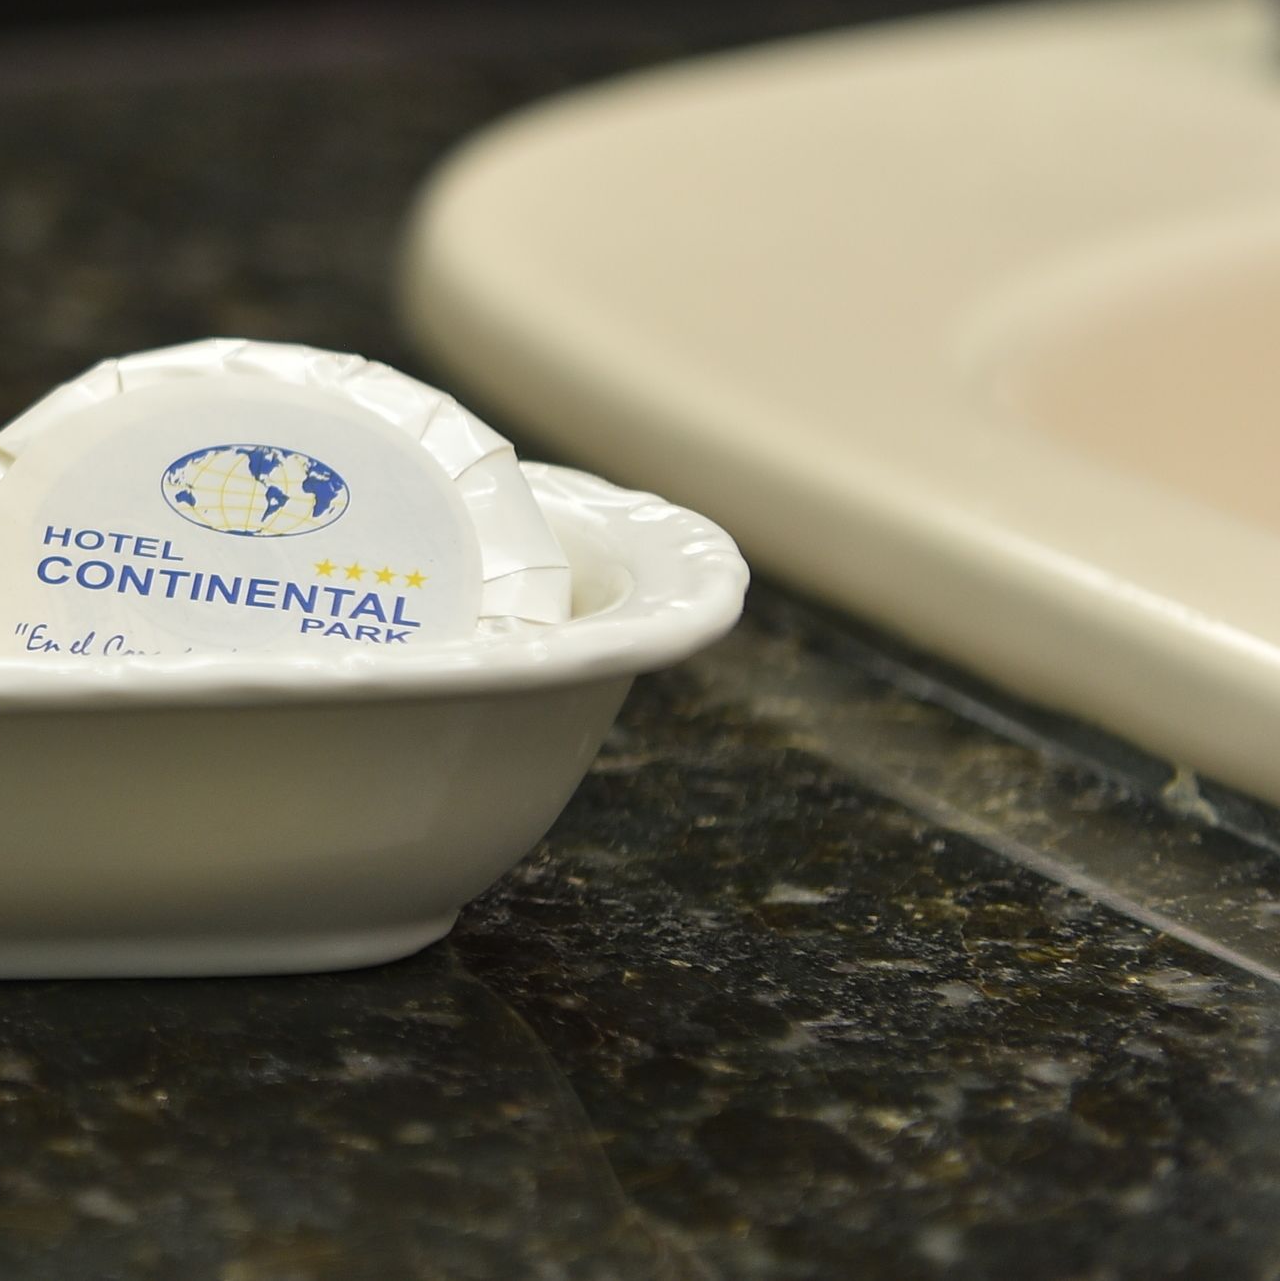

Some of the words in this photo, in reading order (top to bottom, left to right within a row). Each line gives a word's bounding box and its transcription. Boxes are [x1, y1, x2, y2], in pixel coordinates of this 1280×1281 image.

[42, 525, 185, 562] HOTEL
[36, 555, 422, 629] CONTINENTAL
[300, 618, 411, 645] PARK
